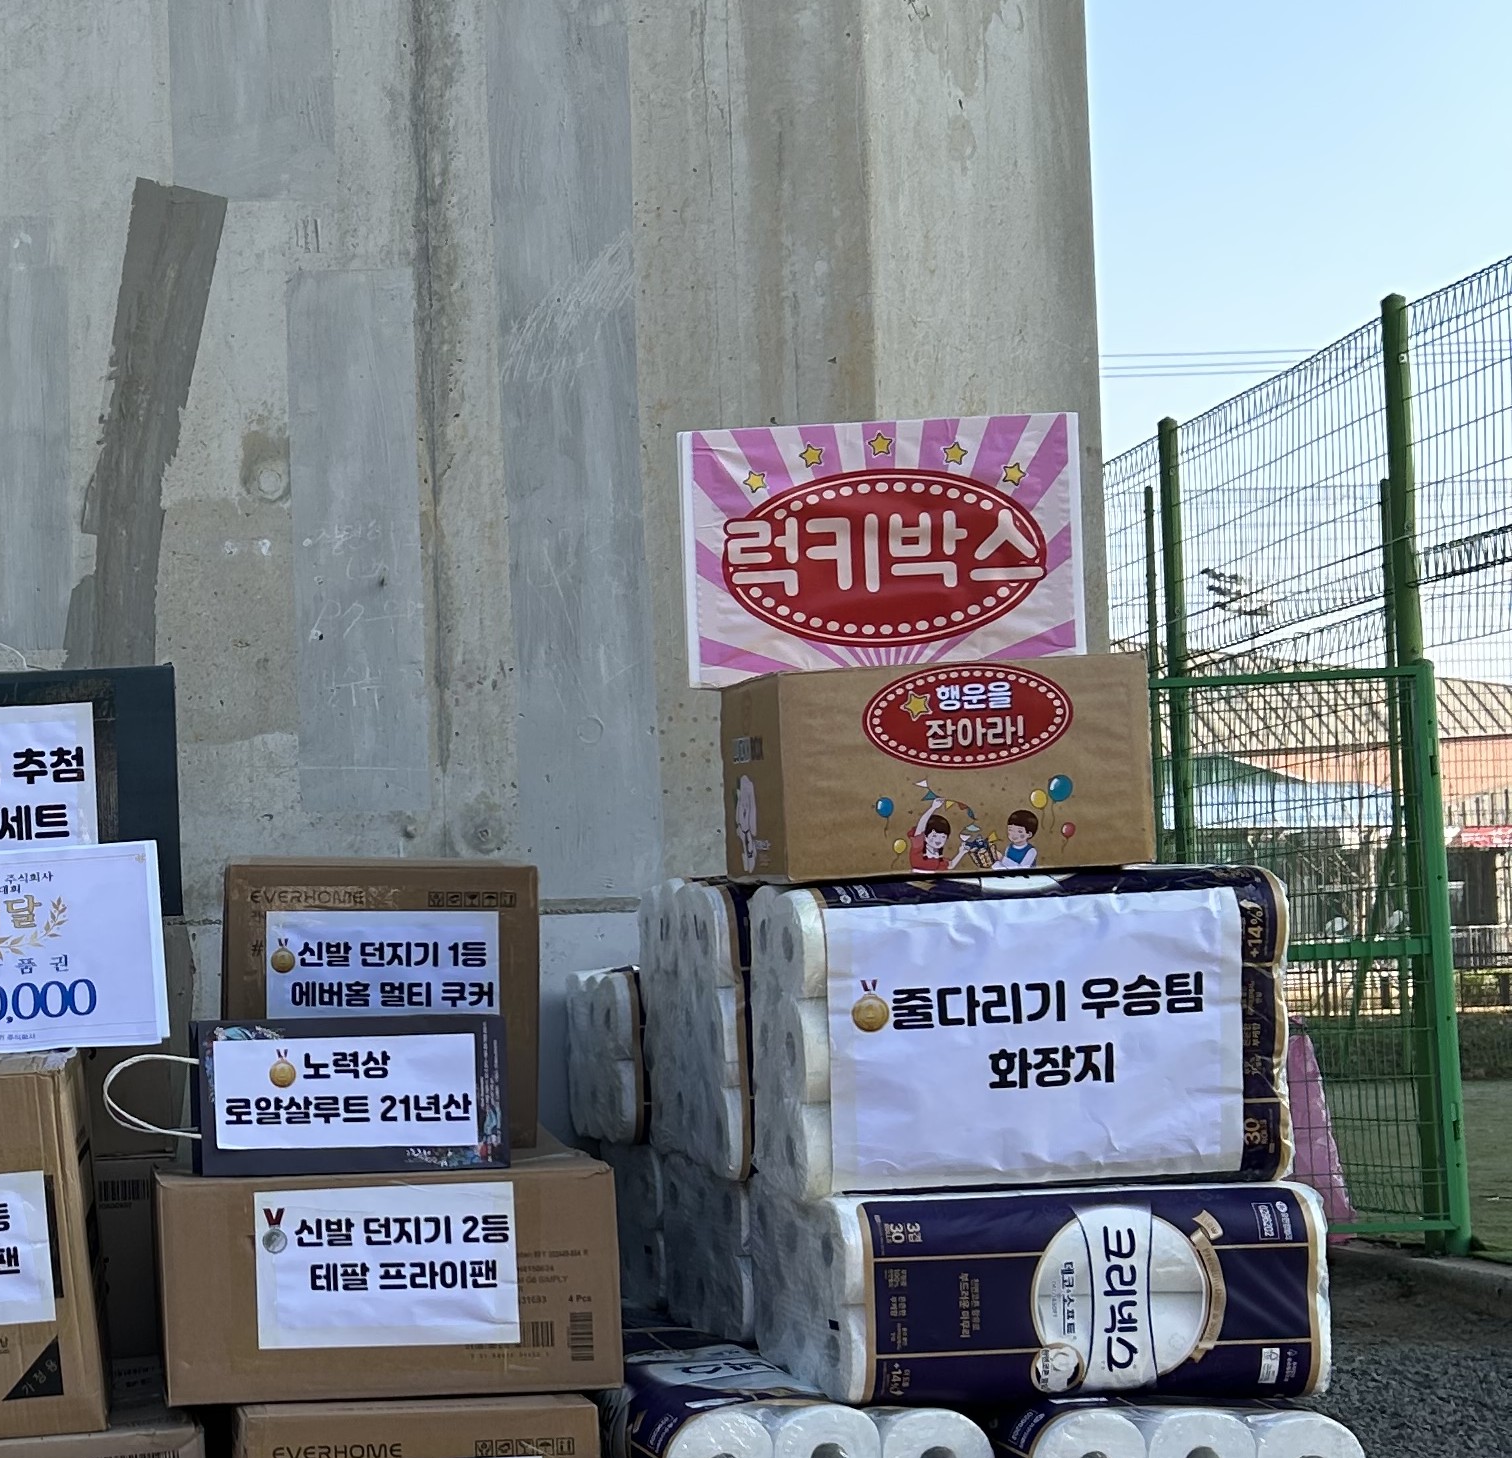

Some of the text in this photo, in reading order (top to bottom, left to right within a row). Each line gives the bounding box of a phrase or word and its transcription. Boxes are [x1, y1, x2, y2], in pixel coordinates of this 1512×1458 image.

[725, 508, 1045, 597] 럭키박스
[935, 681, 1012, 711] 행운을
[925, 716, 1025, 751] 잡아라!
[12, 746, 86, 784] 추첨
[4, 870, 54, 885] 주식회사
[250, 889, 365, 905] EVERHOME
[297, 941, 353, 969] 신발
[360, 940, 440, 969] 던지기
[447, 941, 488, 968] 1등
[290, 980, 495, 1010] 에버홈 멀티 쿠커
[892, 979, 1068, 1028] 줄다리기
[1080, 970, 1206, 1019] 우승팀
[302, 1050, 391, 1080] 노력상
[987, 1042, 1118, 1092] 화장지
[224, 1093, 473, 1126] 로얄살루트 21년산
[1244, 1117, 1261, 1146] 30
[294, 1214, 510, 1248] 신발 던지기 2등
[889, 1223, 905, 1244] 30
[906, 1222, 922, 1244] 3겹
[309, 1259, 499, 1293] 테팔 프라이팬
[1103, 1225, 1139, 1373] 크리넥스
